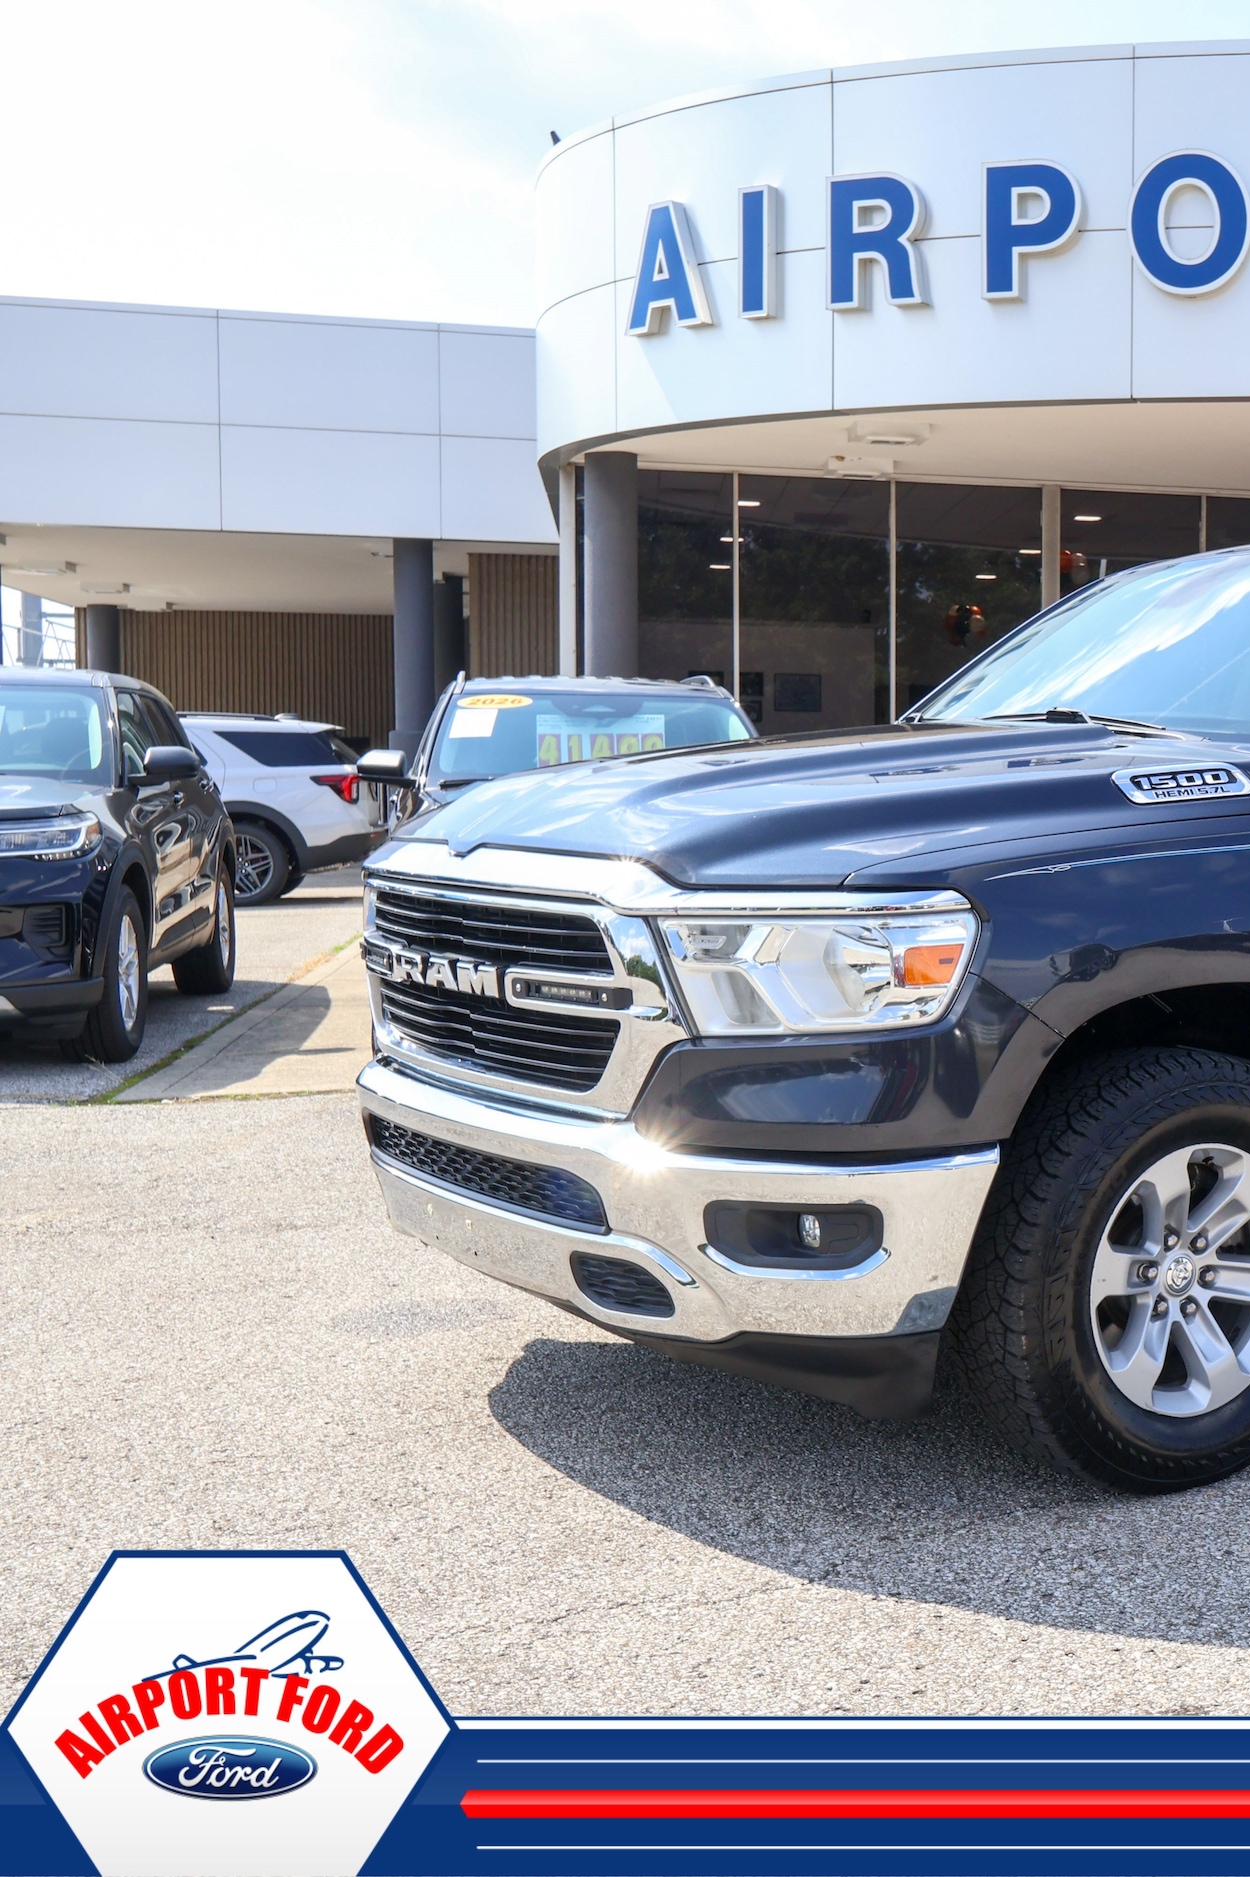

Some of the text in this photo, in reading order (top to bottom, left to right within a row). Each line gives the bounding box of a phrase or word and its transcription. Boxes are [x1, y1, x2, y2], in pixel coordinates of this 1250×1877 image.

[466, 697, 524, 706] 2026
[1134, 770, 1230, 790] 1500
[1154, 785, 1231, 799] HEMI 5.7L
[392, 949, 500, 999] RAM
